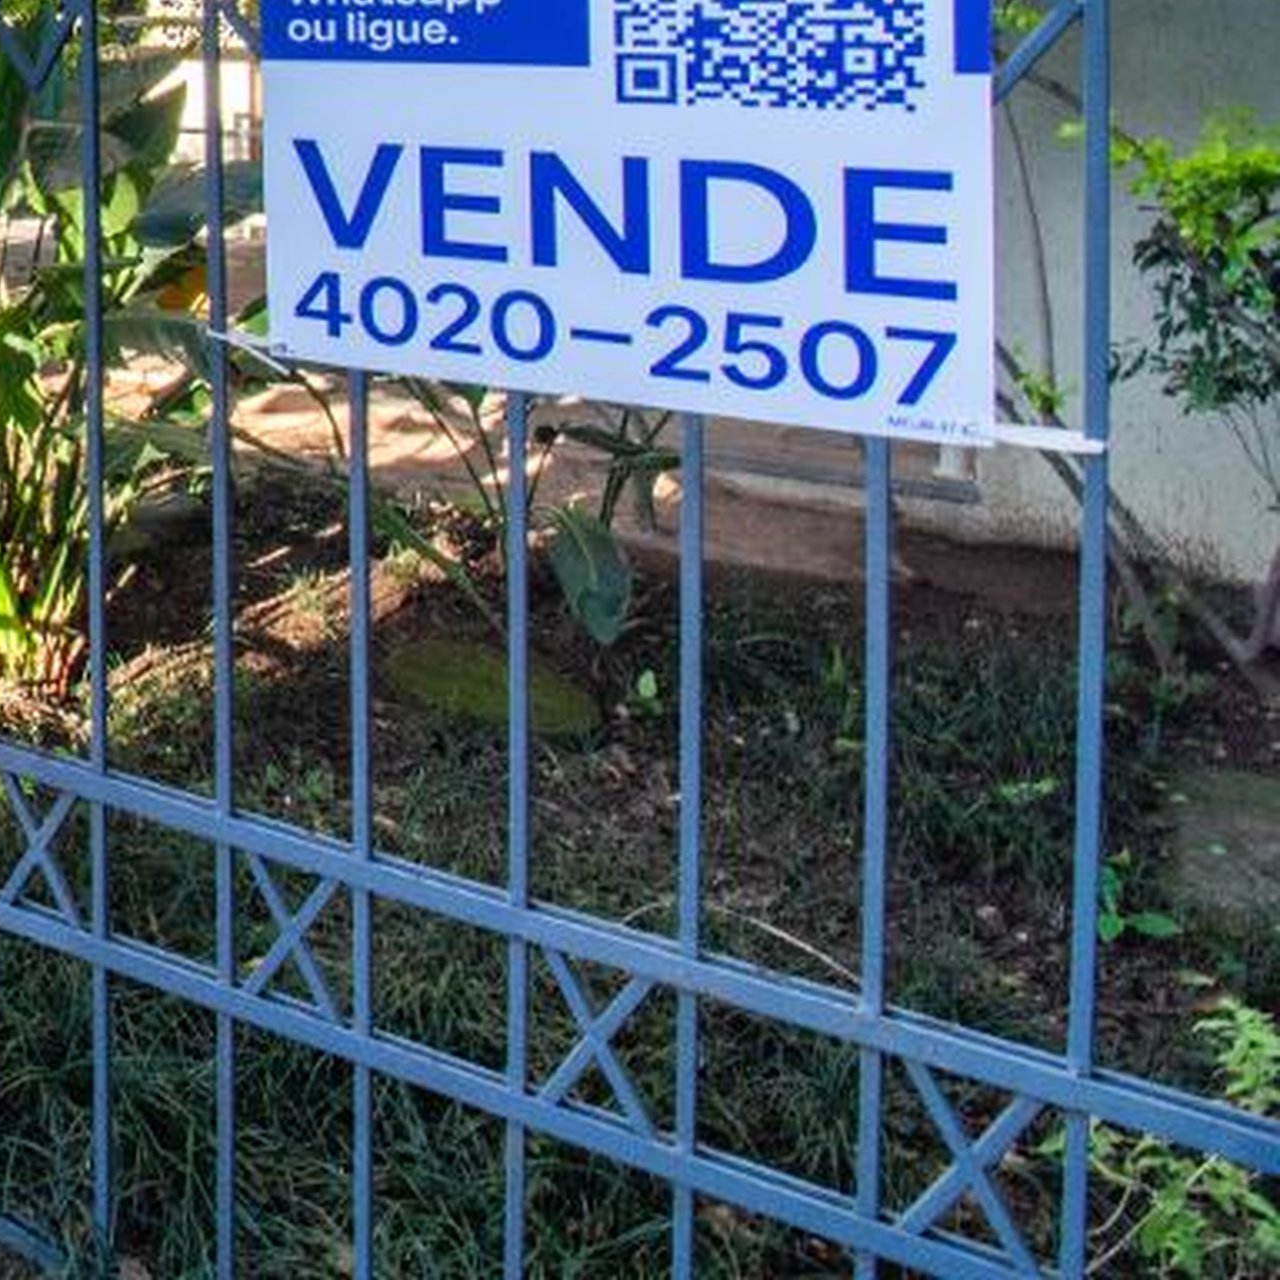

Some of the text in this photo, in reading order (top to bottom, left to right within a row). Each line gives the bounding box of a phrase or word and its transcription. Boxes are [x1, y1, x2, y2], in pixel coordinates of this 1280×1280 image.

[287, 13, 460, 52] ou ligue.
[293, 139, 958, 301] VENDE
[294, 271, 958, 407] 4020-2507
